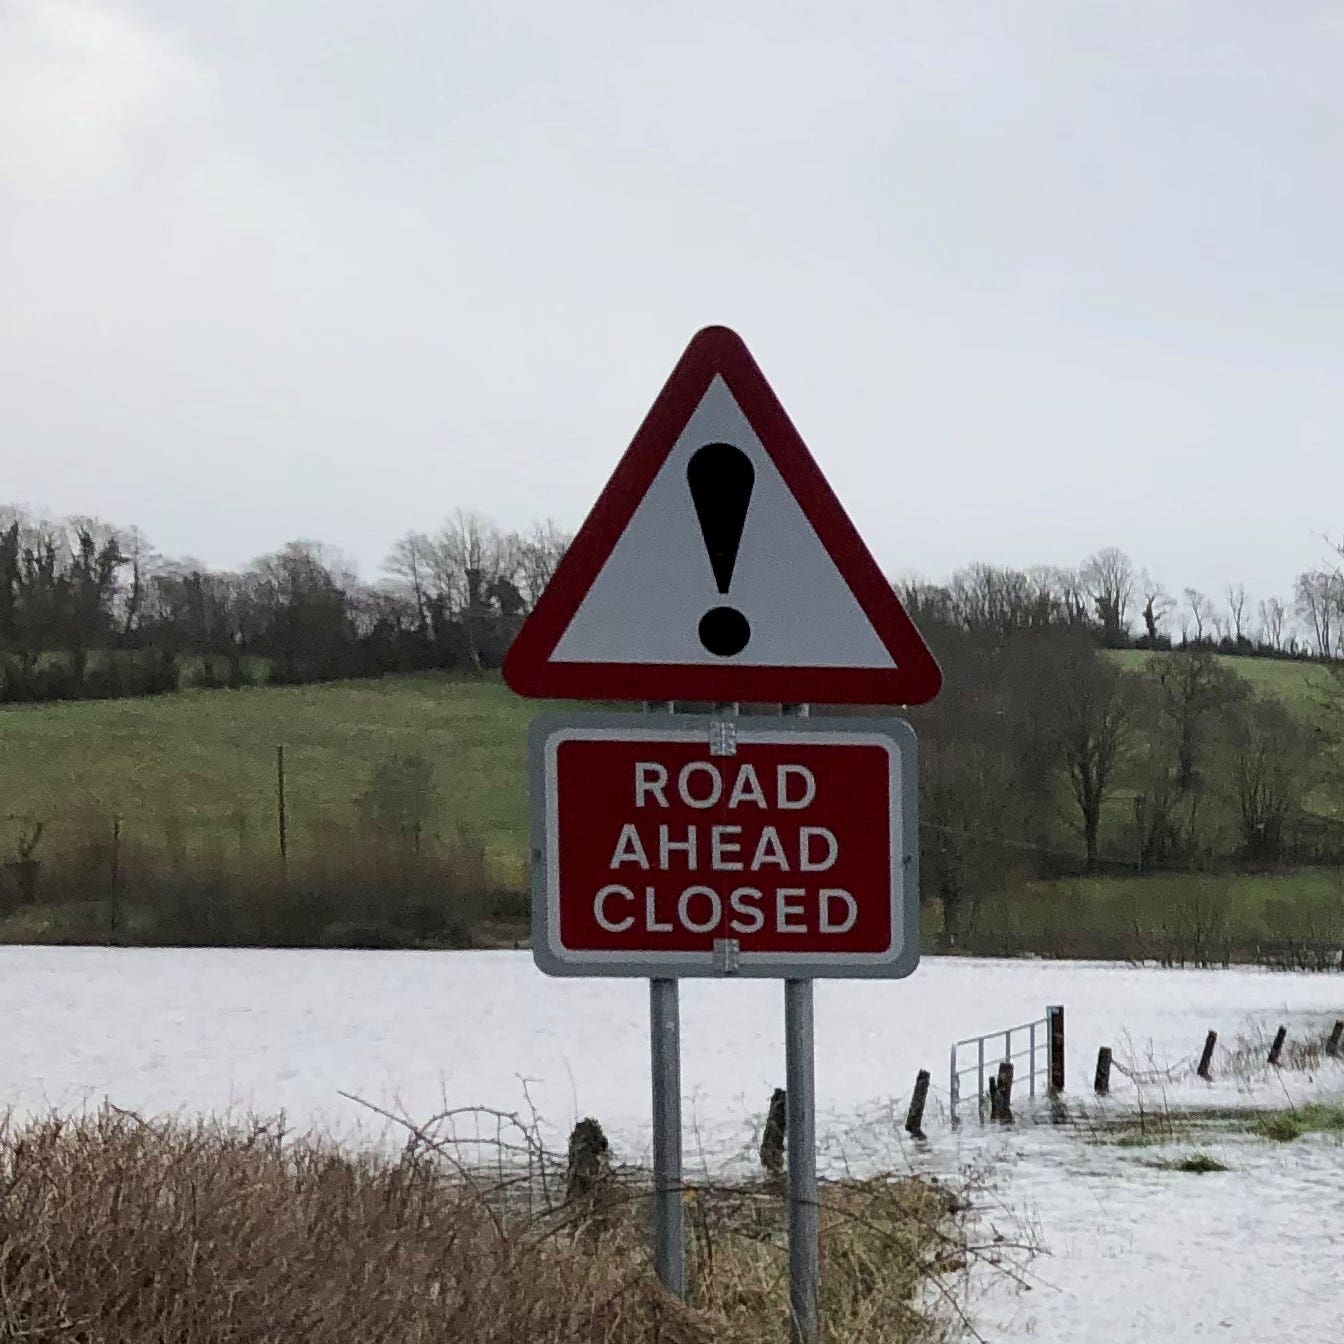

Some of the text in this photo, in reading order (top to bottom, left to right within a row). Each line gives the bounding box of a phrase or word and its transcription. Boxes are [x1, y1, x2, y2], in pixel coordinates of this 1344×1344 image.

[635, 761, 816, 810] ROAD
[610, 823, 839, 872] AHEAD
[593, 884, 858, 934] CLOSED
